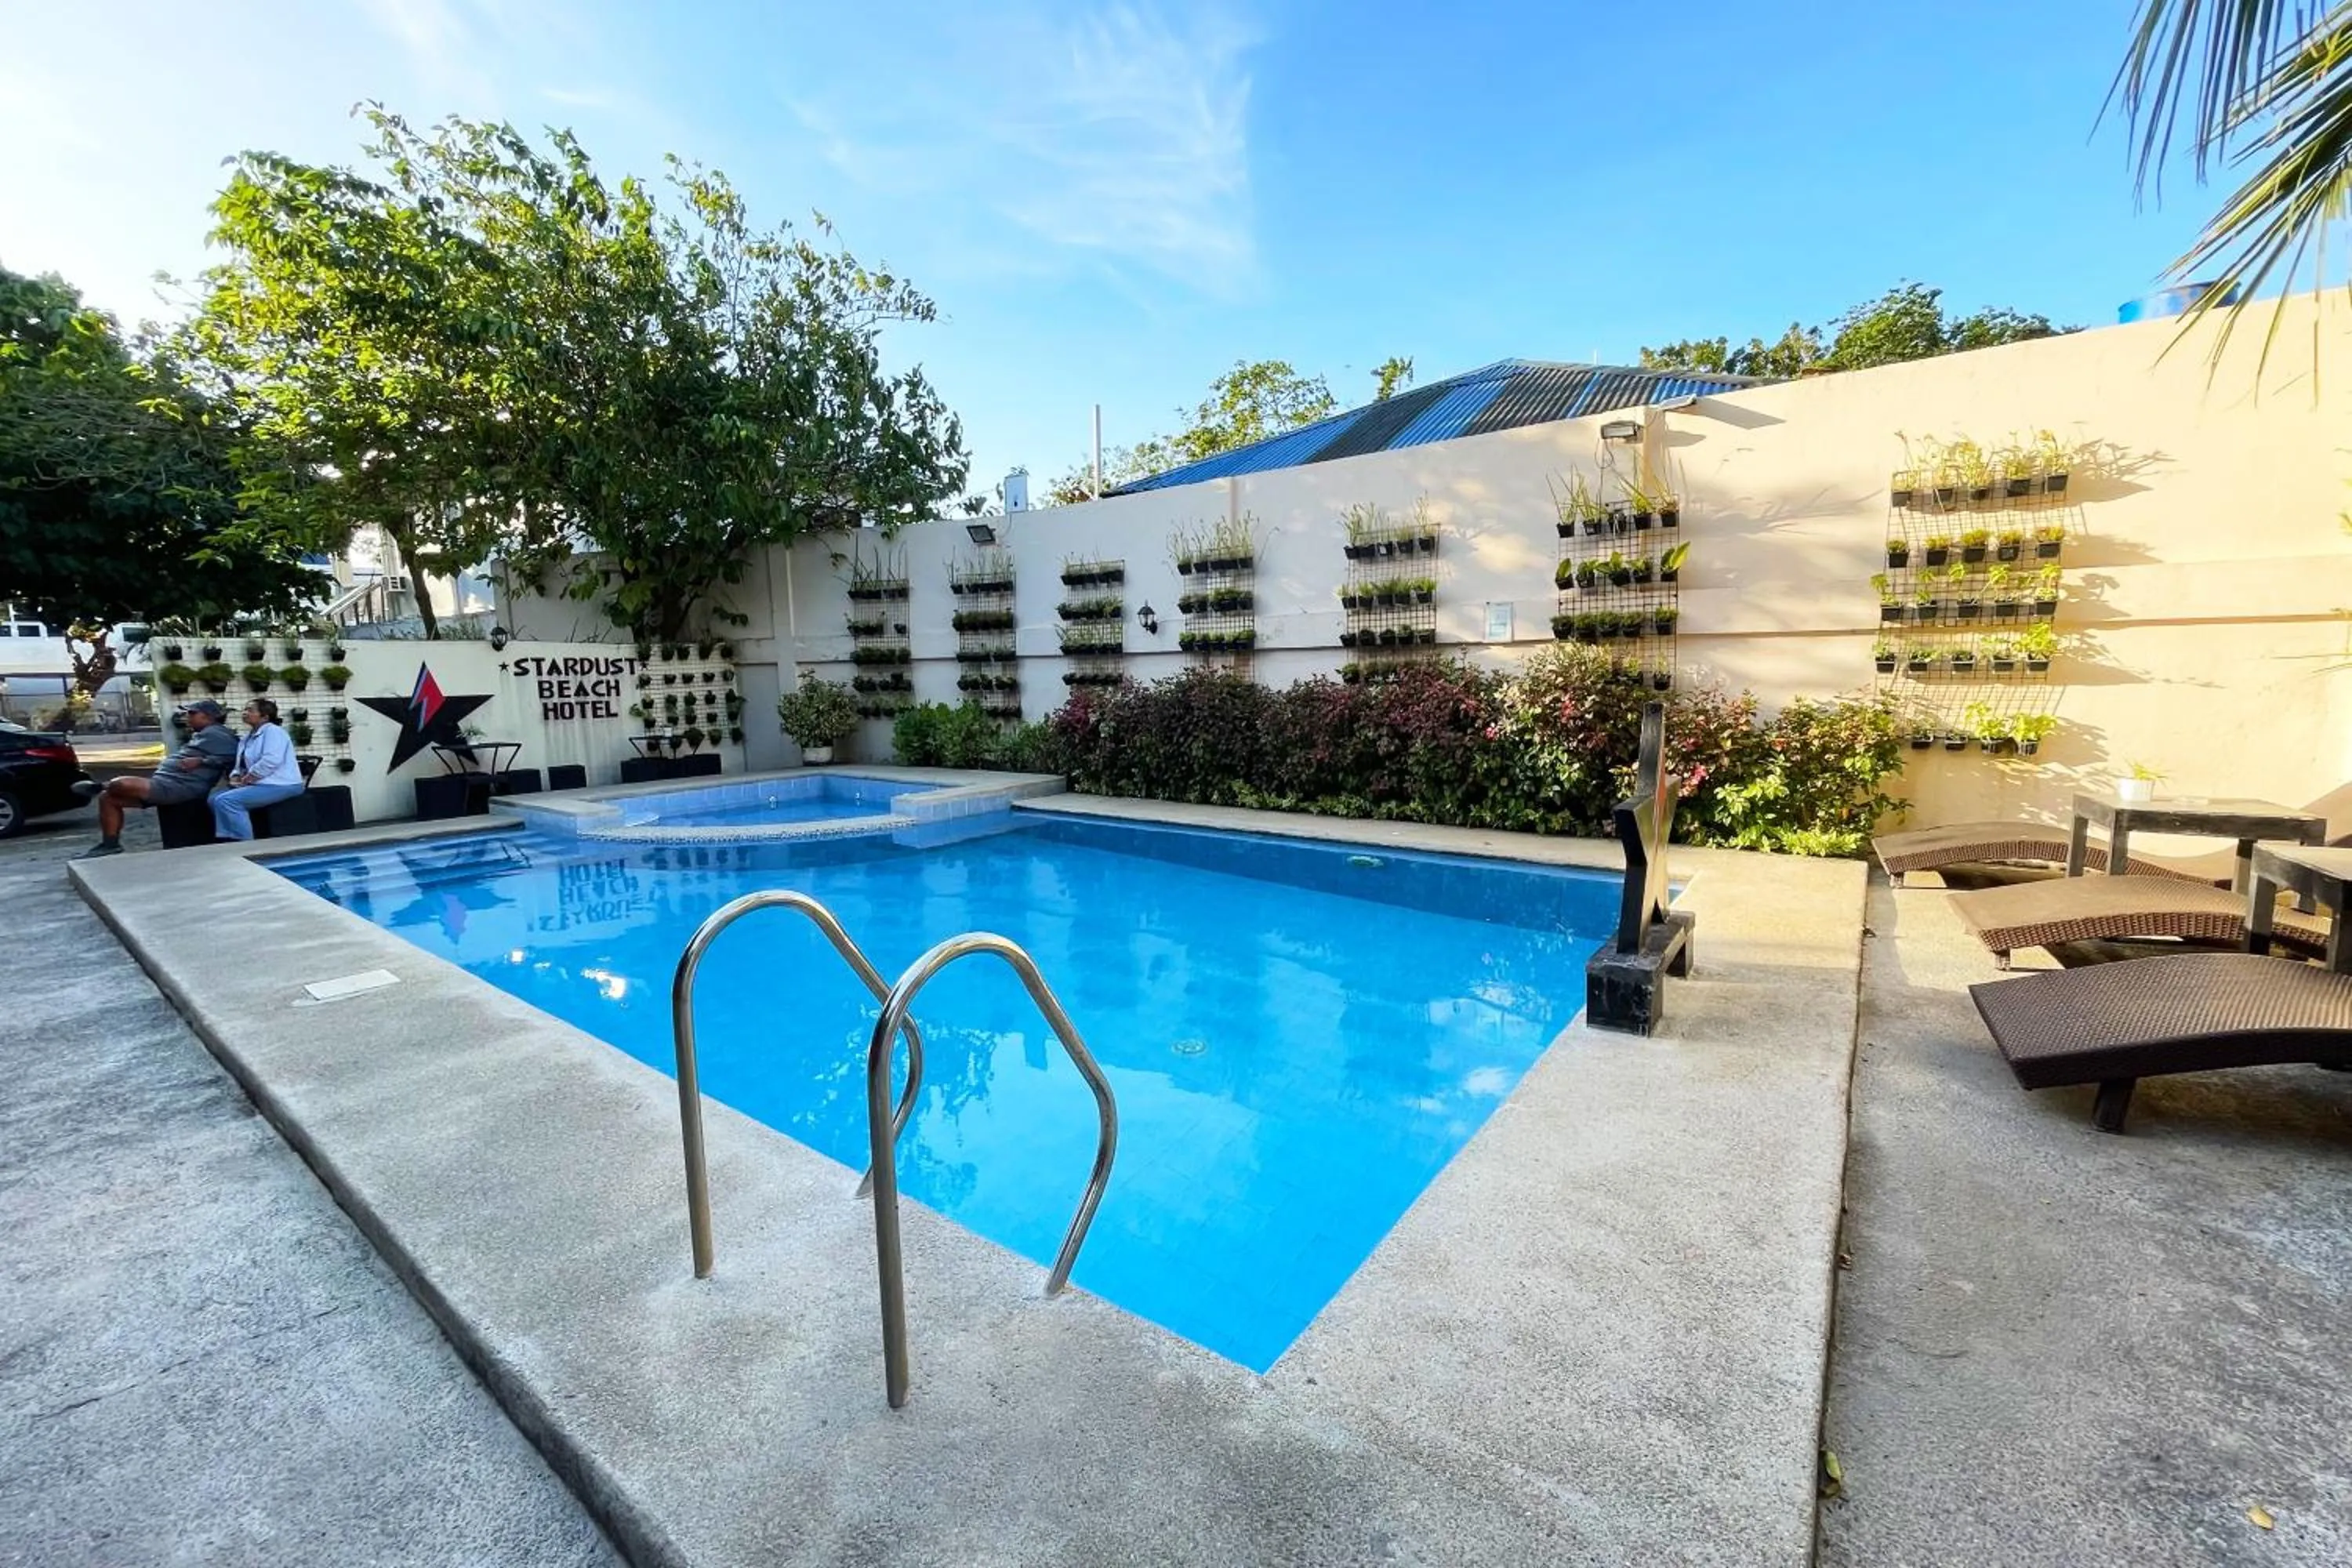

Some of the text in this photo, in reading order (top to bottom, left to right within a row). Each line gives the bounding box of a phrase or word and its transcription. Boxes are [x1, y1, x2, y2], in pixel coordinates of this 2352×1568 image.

[514, 658, 637, 677] STARDUST
[538, 680, 620, 699] BEACH
[543, 701, 619, 720] HOTEL
